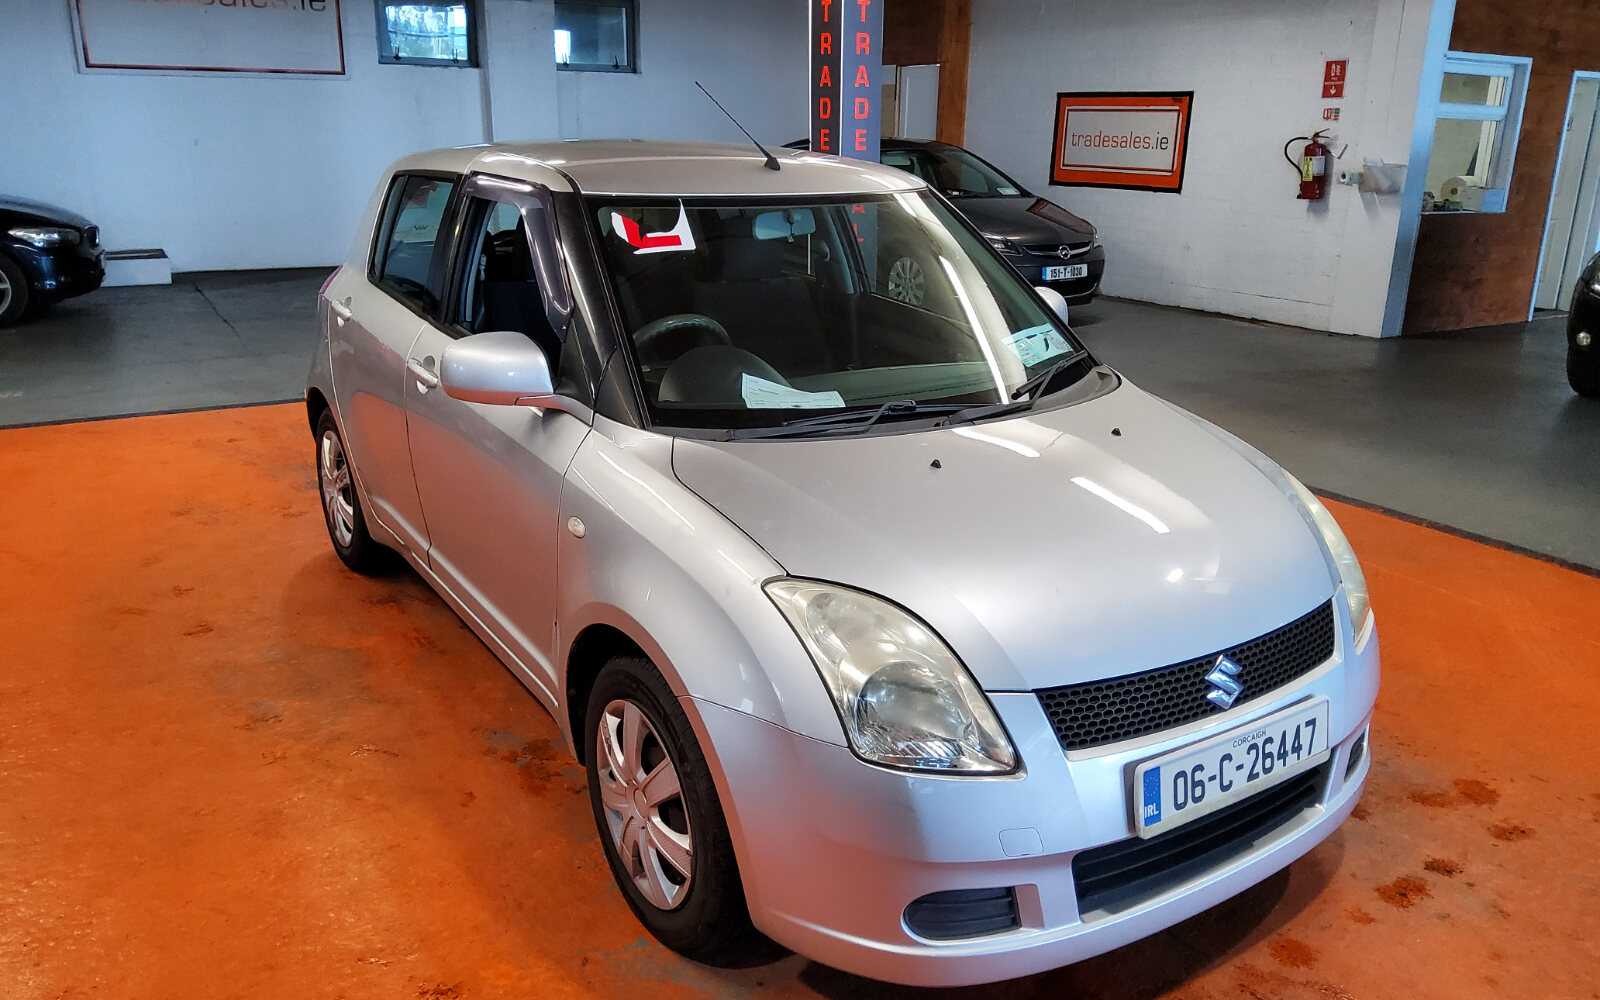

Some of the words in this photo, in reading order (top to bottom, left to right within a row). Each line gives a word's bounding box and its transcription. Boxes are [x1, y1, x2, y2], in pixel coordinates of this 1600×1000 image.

[819, 0, 832, 151] TRADE
[854, 0, 871, 151] TRADE
[1071, 130, 1169, 150] tradesales.ie
[1173, 717, 1317, 811] 06-C-26447
[1232, 729, 1267, 748] CORCAIGH
[1144, 803, 1159, 819] IRL
